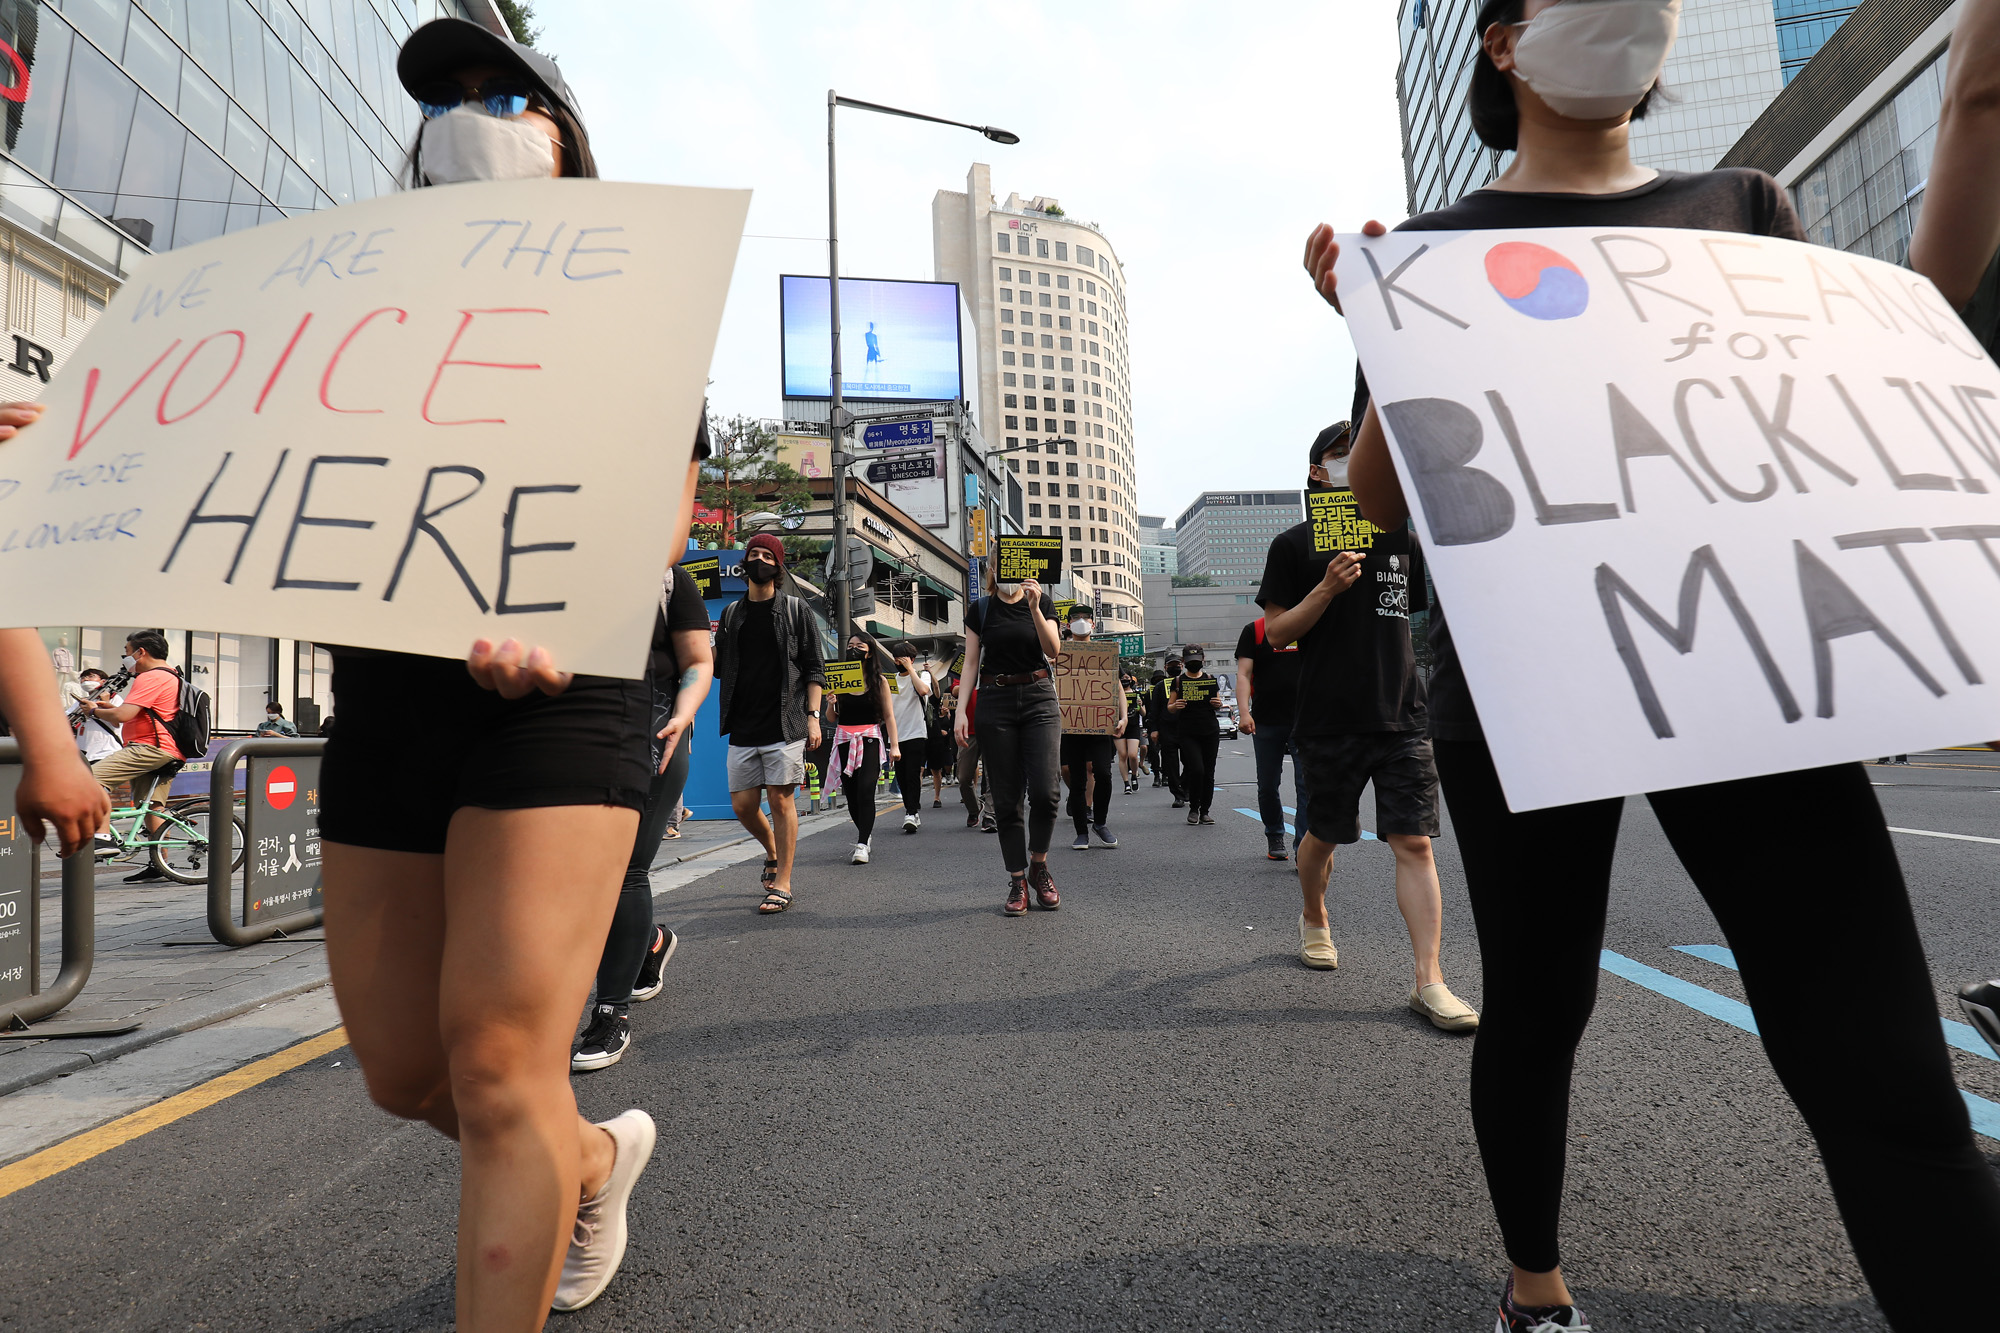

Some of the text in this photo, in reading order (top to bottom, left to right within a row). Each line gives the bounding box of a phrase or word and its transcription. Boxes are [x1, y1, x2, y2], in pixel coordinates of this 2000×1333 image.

[131, 218, 631, 323] WE ARE THE
[1665, 321, 1812, 363] for
[66, 307, 551, 461] VOICE
[899, 422, 930, 436] 명동길
[890, 459, 932, 472] 유네스코길
[1382, 373, 1859, 547] BLACK
[892, 470, 930, 479] UNESCO-Rd
[1310, 494, 1357, 505] WE AGAIN
[1311, 506, 1356, 522] 우리는
[160, 448, 583, 617] HERE
[1313, 533, 1374, 552] 반대한다
[1000, 548, 1030, 559] 우리는
[719, 565, 745, 577] LIC
[1000, 559, 1049, 569] 인종차별에
[1000, 569, 1040, 579] 반대한다
[1055, 652, 1110, 677] BLACK
[833, 679, 863, 689] PEACE
[1059, 678, 1112, 701] LIVES
[1059, 705, 1115, 728] MATTER
[257, 835, 284, 856] 걷자,
[306, 842, 321, 856] 매일
[256, 857, 280, 877] 서울
[262, 891, 291, 907] 서울특별시
[0, 966, 24, 982] 서장
